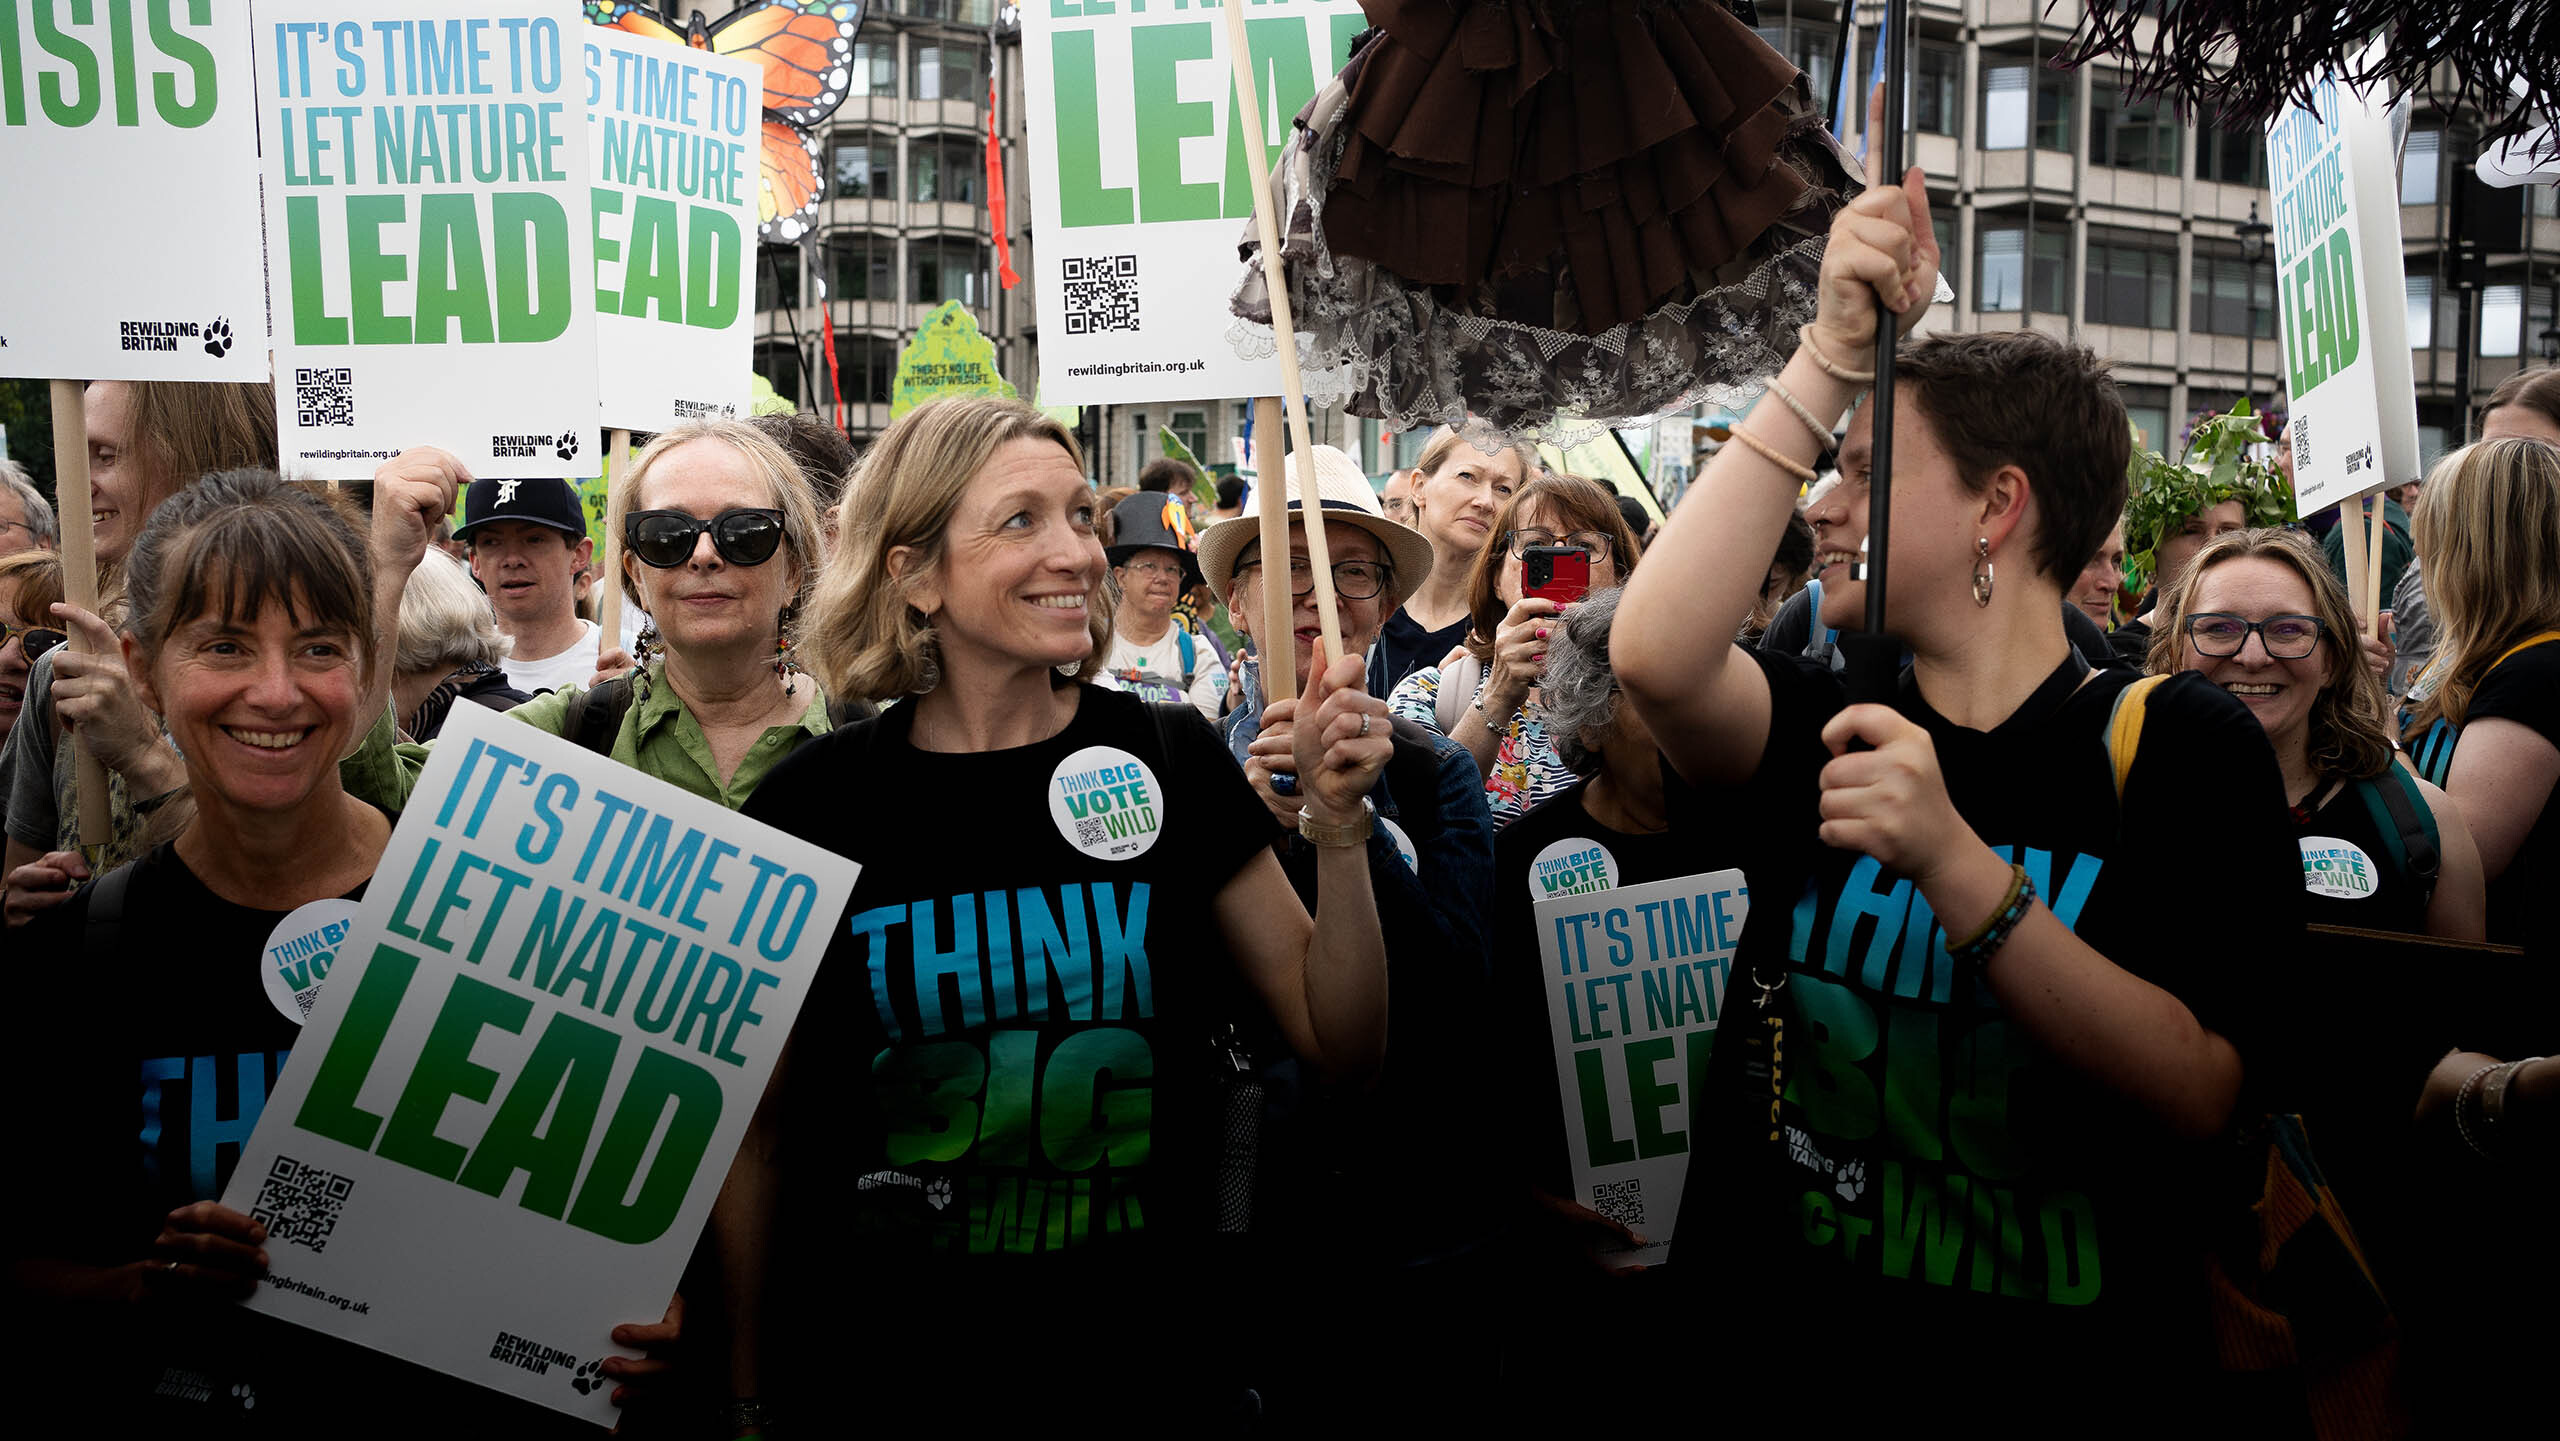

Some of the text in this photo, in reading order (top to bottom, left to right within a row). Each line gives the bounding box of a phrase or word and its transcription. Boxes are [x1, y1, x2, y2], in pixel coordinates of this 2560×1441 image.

[275, 22, 367, 98] IT'S
[381, 20, 493, 96] TIME
[498, 18, 561, 94] TO
[610, 48, 699, 127] TIME
[705, 70, 747, 136] TO
[282, 102, 567, 187] LET NATURE
[602, 116, 745, 206] NATURE
[1051, 14, 1366, 228] LEA
[2276, 141, 2347, 268] LET NATURE
[286, 192, 572, 346] LEAD
[594, 187, 742, 330] EAD
[2282, 227, 2360, 401] LEAD
[903, 375, 945, 387] WITHOUT
[1068, 359, 1205, 376] rewildingbritain.org.uk
[300, 449, 401, 460] rewildingbritain.org.uk
[1057, 762, 1141, 793] THINK BIG
[1064, 780, 1150, 819] VOTE
[434, 738, 818, 964] IT'S TIME TO
[1102, 806, 1157, 840] WILD
[1536, 848, 1602, 875] THINK BIG
[2328, 849, 2363, 862] BIG
[1540, 861, 1607, 892] VOTE
[2323, 872, 2369, 892] WILD
[270, 930, 325, 966] THINK
[279, 945, 341, 992] VO
[386, 837, 780, 1067] LET NATURE
[851, 882, 1154, 1042] THINK
[1555, 890, 1738, 976] IT'S TIME
[1565, 973, 1632, 1044] LET
[294, 945, 723, 1245] LEAD
[871, 1028, 1153, 1172] BIG
[1800, 1158, 2103, 1305] CT WILD
[264, 1270, 370, 1315] ingbritain.org.uk
